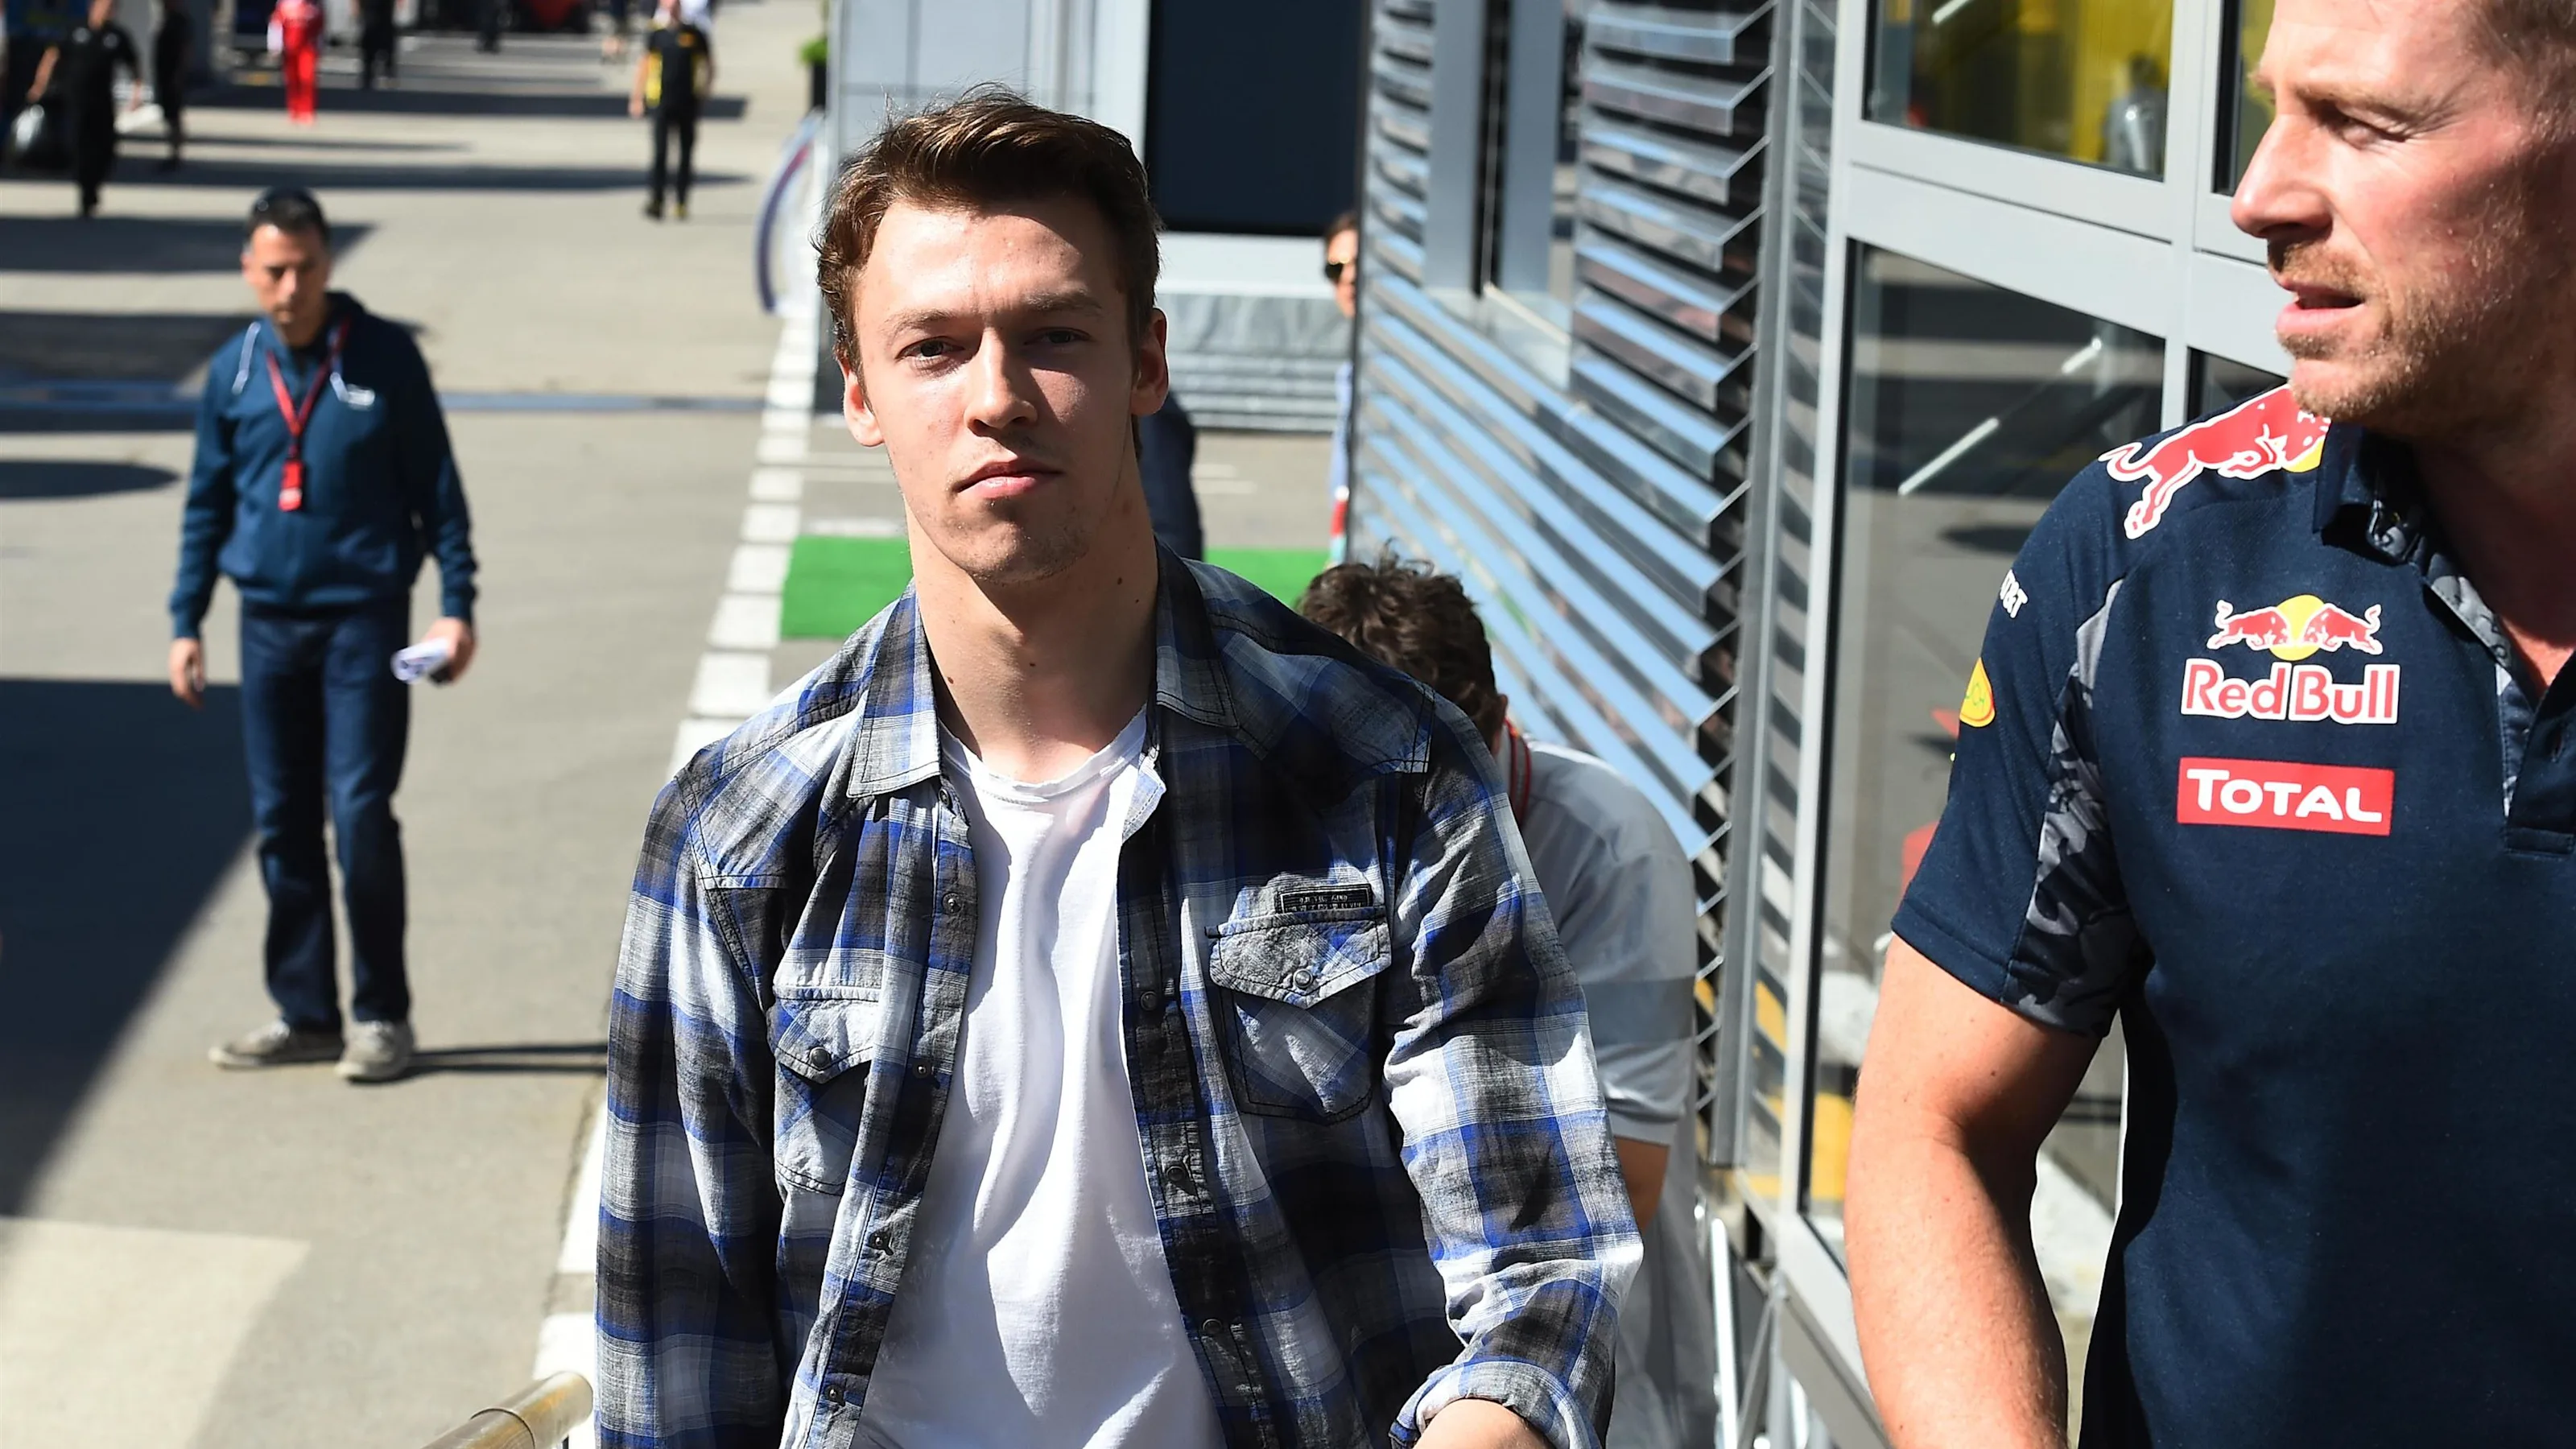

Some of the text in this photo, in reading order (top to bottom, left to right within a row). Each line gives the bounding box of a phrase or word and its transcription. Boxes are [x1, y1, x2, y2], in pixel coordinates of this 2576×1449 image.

[2184, 662, 2397, 721] Red Bull
[2186, 768, 2382, 823] TOTAL
